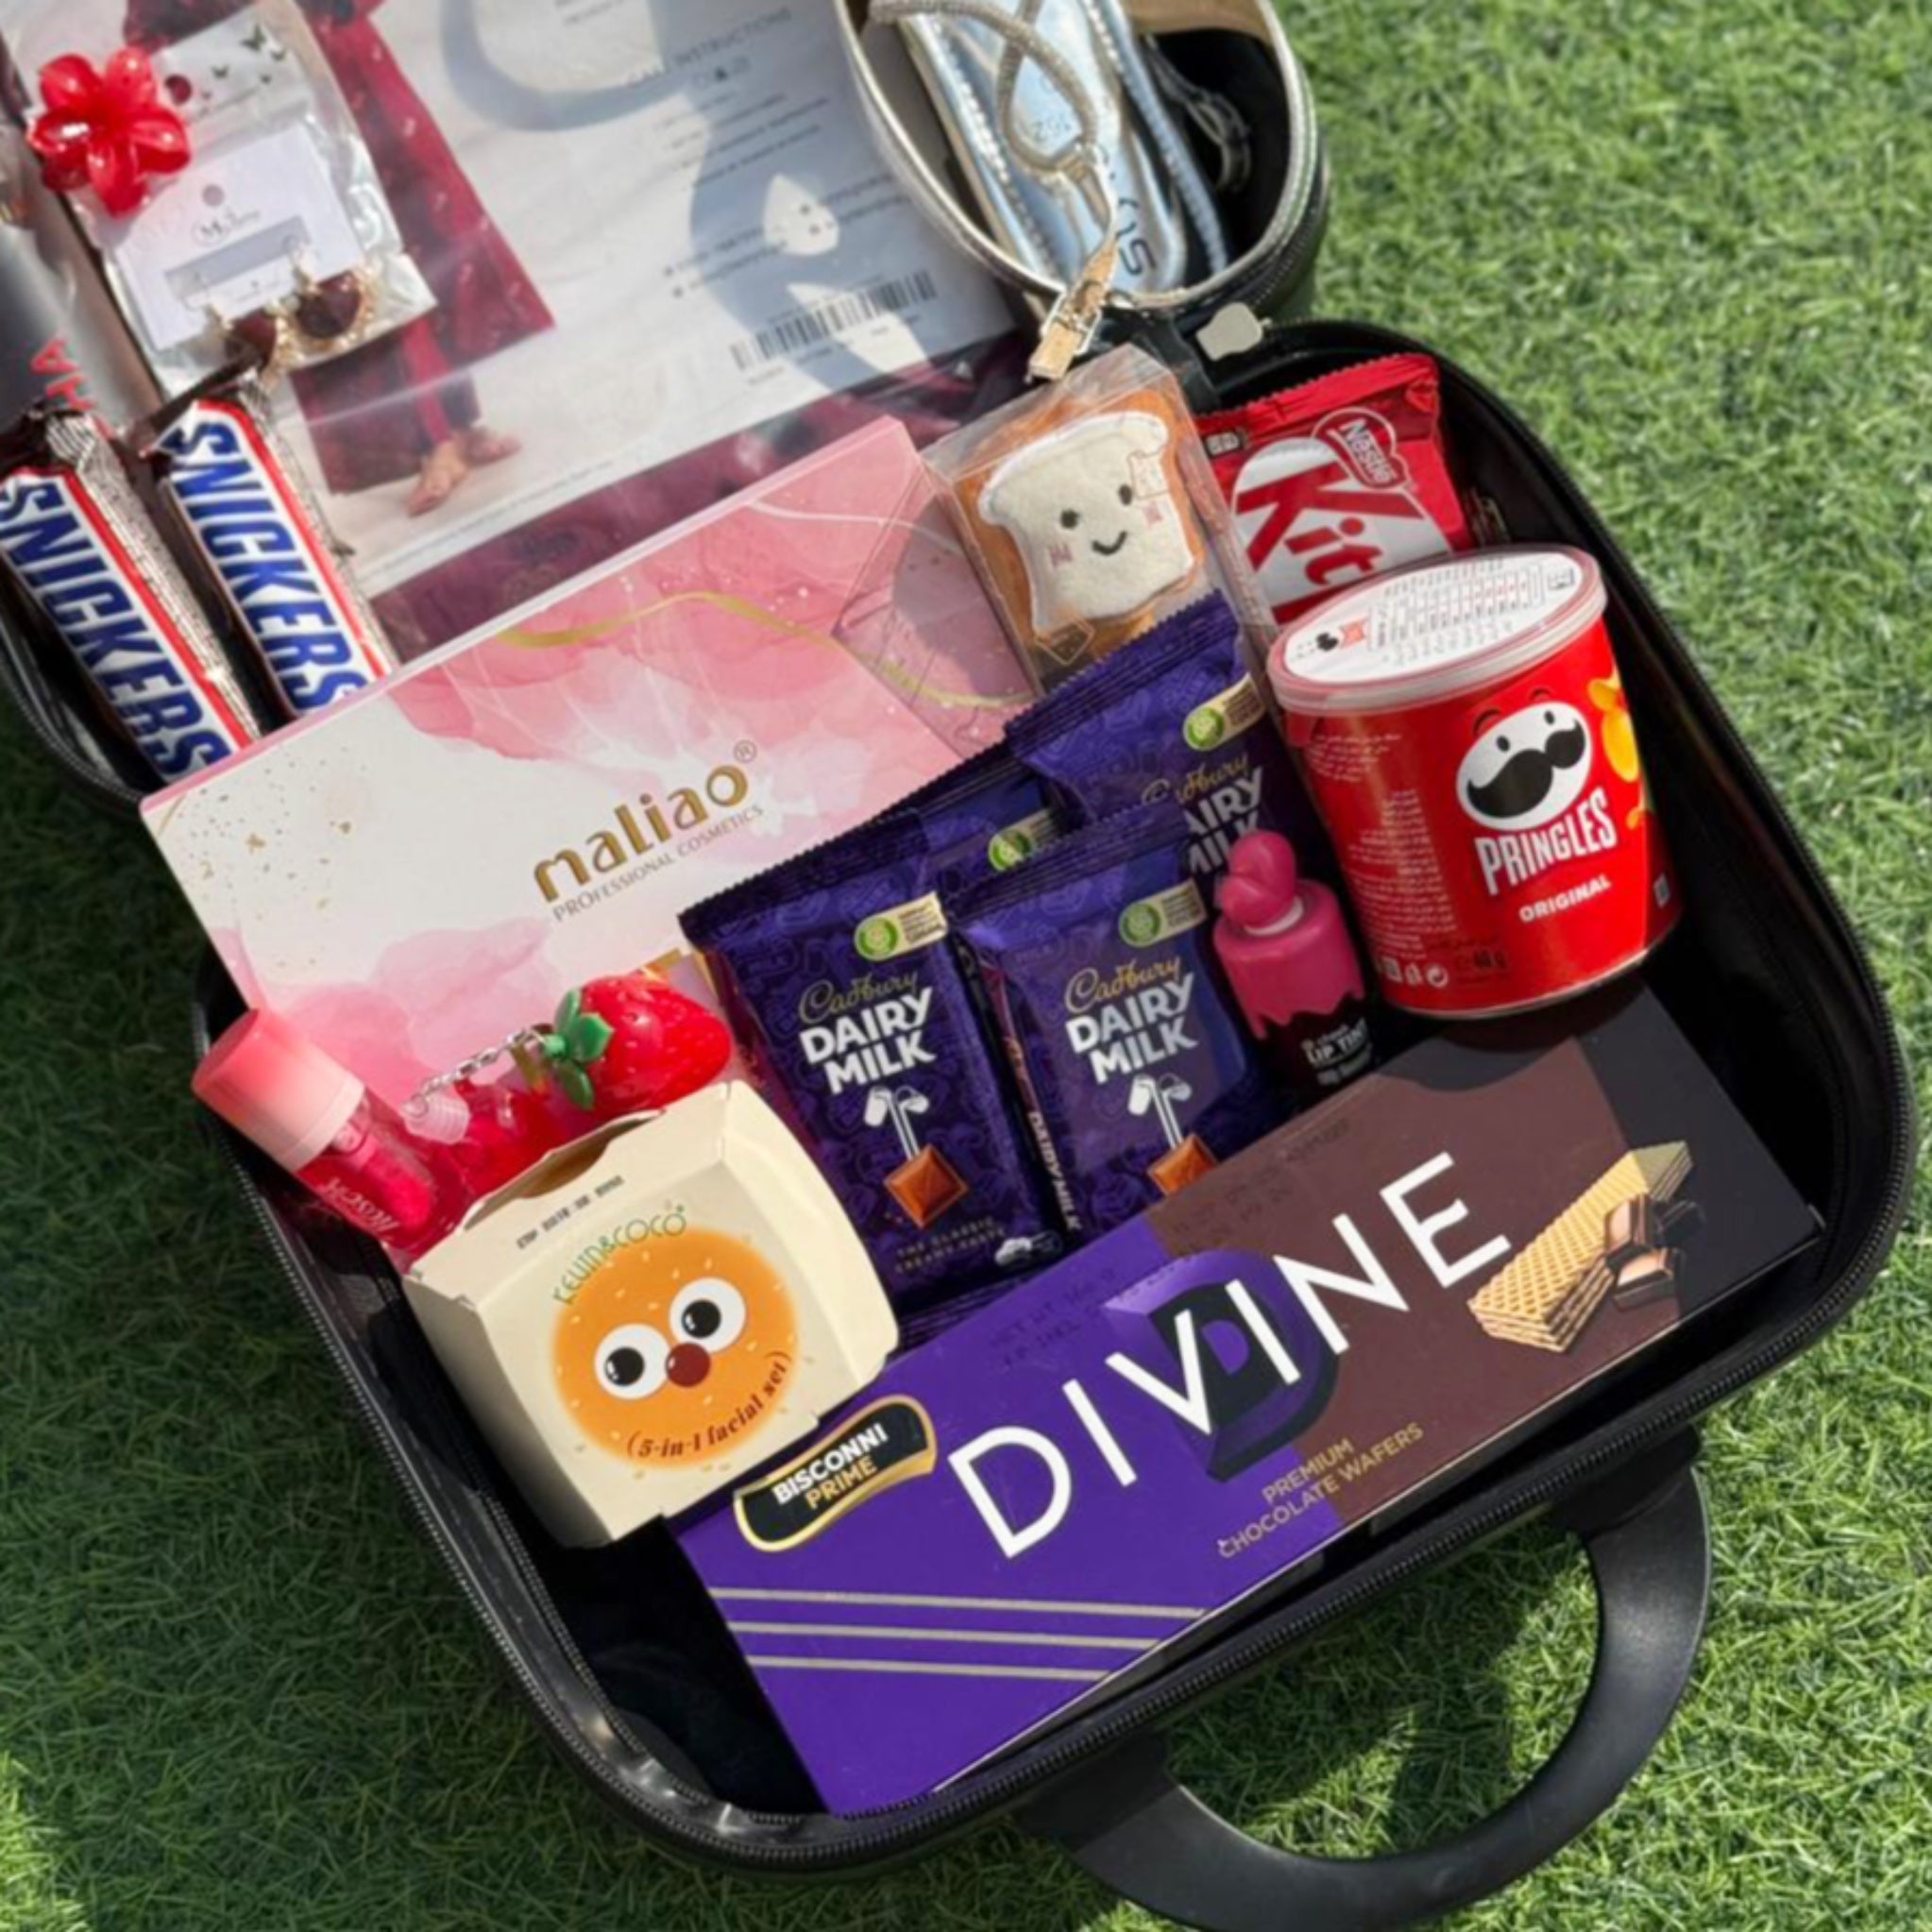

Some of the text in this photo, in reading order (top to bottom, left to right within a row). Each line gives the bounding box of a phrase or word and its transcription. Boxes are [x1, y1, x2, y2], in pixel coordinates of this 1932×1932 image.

[162, 422, 370, 718] SNICKERS
[0, 479, 234, 784] SNICKERS
[534, 765, 749, 904] maliao
[553, 805, 763, 923] PROFESSIONAL COSMETICS
[1474, 787, 1618, 896] PRINGLES
[1519, 873, 1612, 923] ORIGINAL
[798, 971, 918, 1024] Cadbury
[1064, 957, 1181, 1013] Cadbury
[1065, 973, 1195, 1053] DAIRY
[800, 987, 932, 1064] DAIRY
[824, 1029, 937, 1095] MILK
[1090, 1016, 1198, 1084] MILK
[948, 1151, 1512, 1560] DIVINE
[707, 1395, 764, 1447] facial
[771, 1423, 890, 1506] BISCONNI
[805, 1454, 877, 1511] PRIME
[1217, 1422, 1424, 1559] CHOCOLATE WAFERS
[1262, 1437, 1355, 1504] PREMIUM
